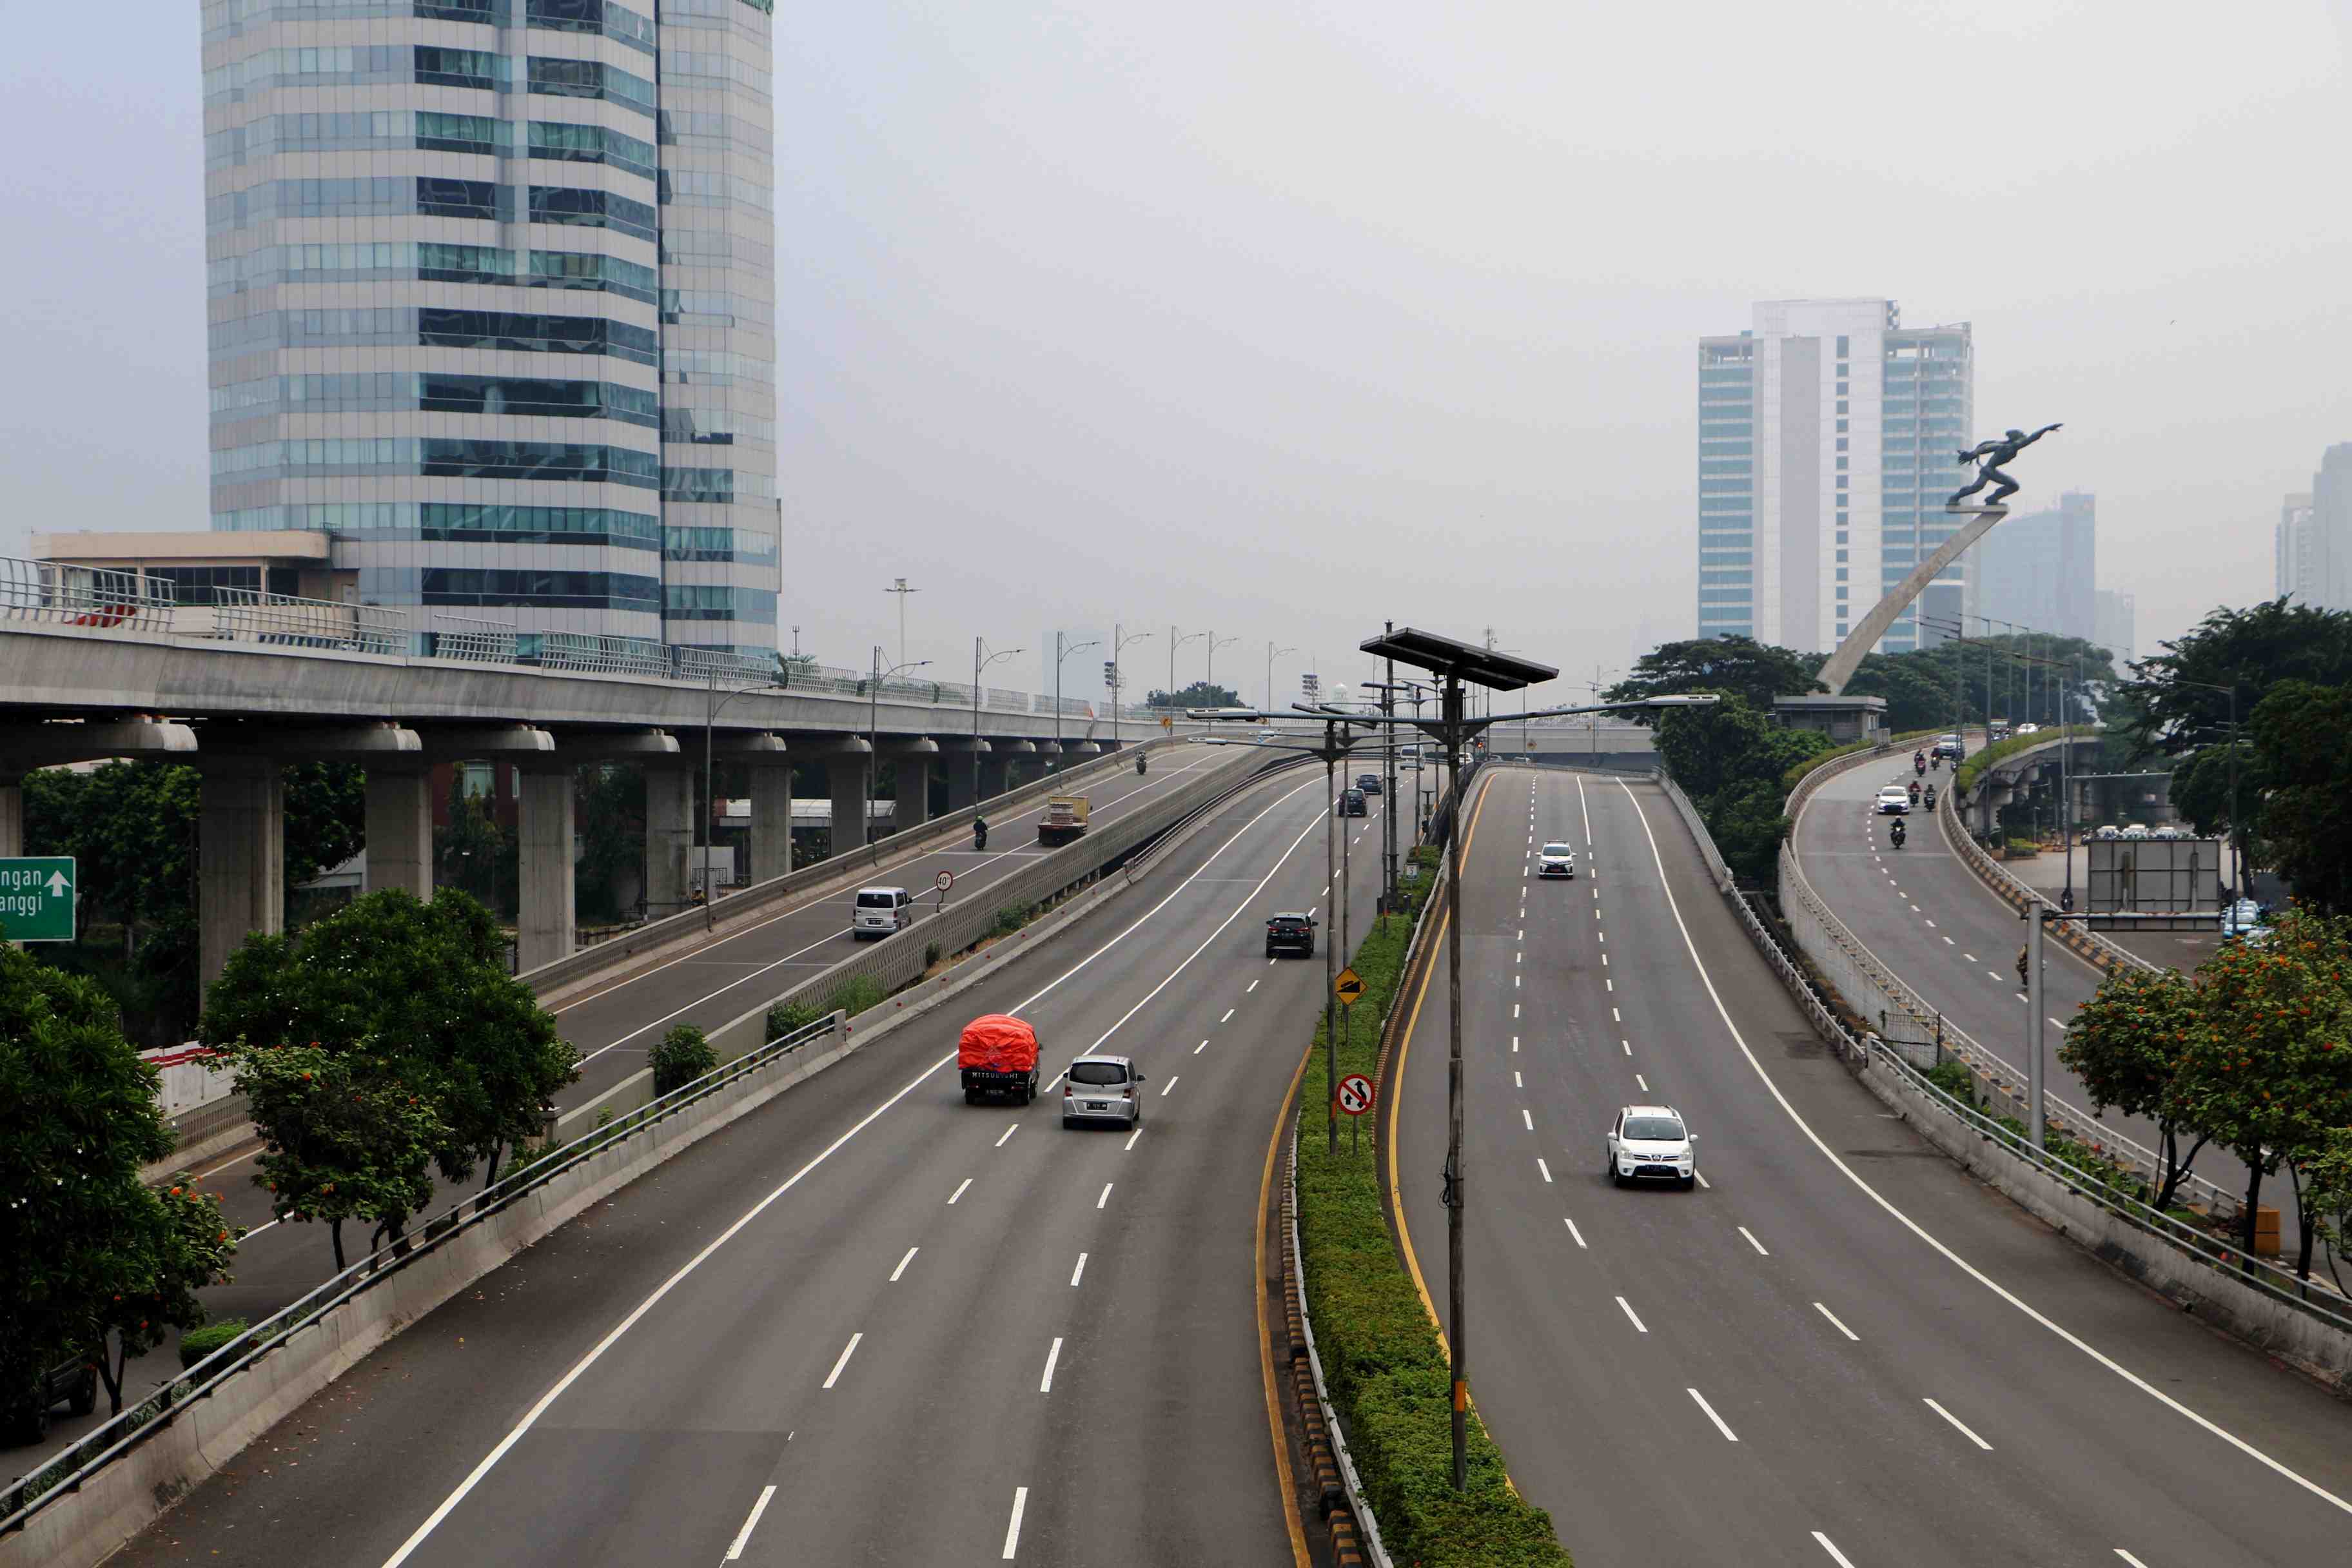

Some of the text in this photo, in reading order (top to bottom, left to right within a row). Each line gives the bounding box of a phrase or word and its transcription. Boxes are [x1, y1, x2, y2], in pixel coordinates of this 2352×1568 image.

[1, 870, 42, 892] ngan
[938, 876, 946, 885] 40
[0, 891, 42, 917] anggi
